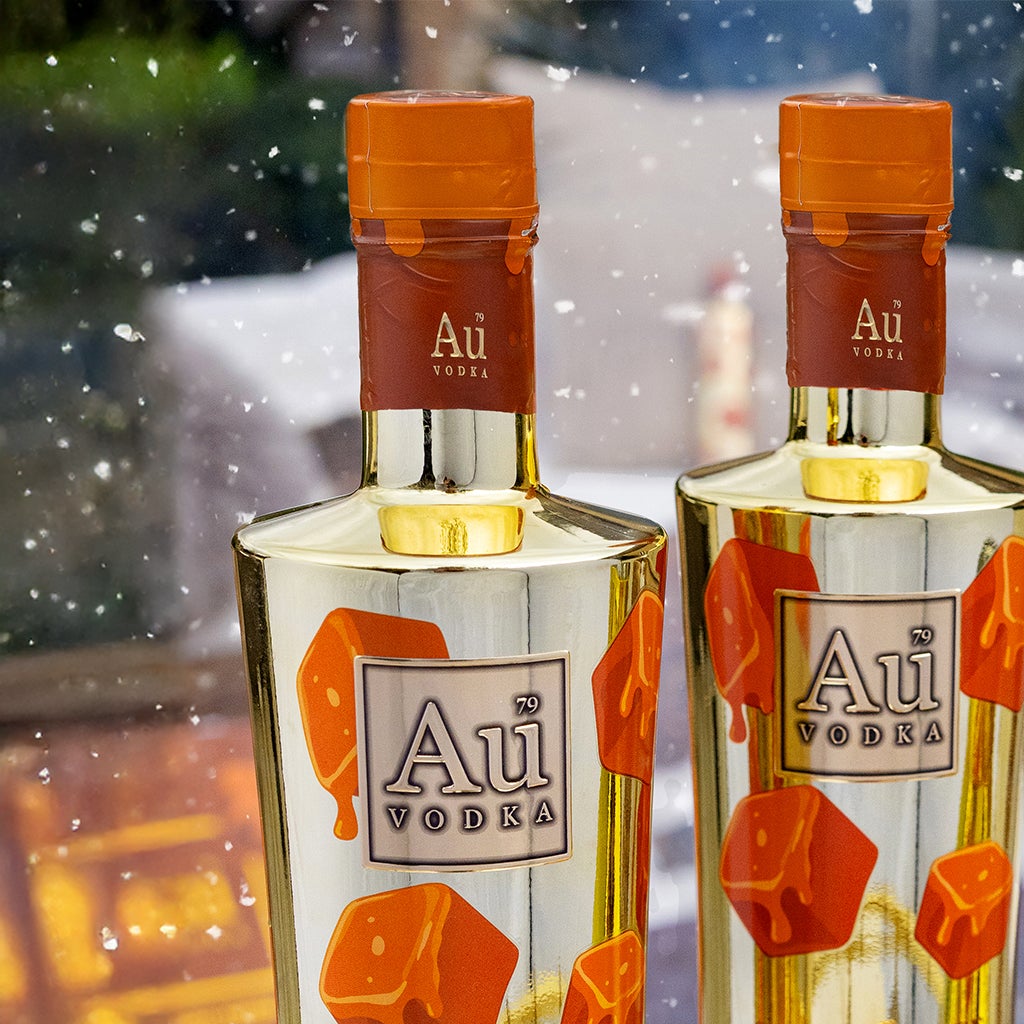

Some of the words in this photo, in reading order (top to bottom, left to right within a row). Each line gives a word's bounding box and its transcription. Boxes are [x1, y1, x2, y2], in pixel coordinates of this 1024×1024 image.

[892, 299, 902, 309] 79
[475, 312, 485, 323] 79
[851, 298, 903, 343] Au
[431, 311, 487, 360] Au
[853, 347, 903, 361] VODKA
[433, 365, 488, 379] VODKA
[911, 629, 932, 645] 79
[797, 630, 938, 714] Au
[516, 696, 539, 715] 79
[799, 723, 942, 745] VODKA
[386, 701, 549, 794] Au
[388, 802, 553, 829] VODKA
